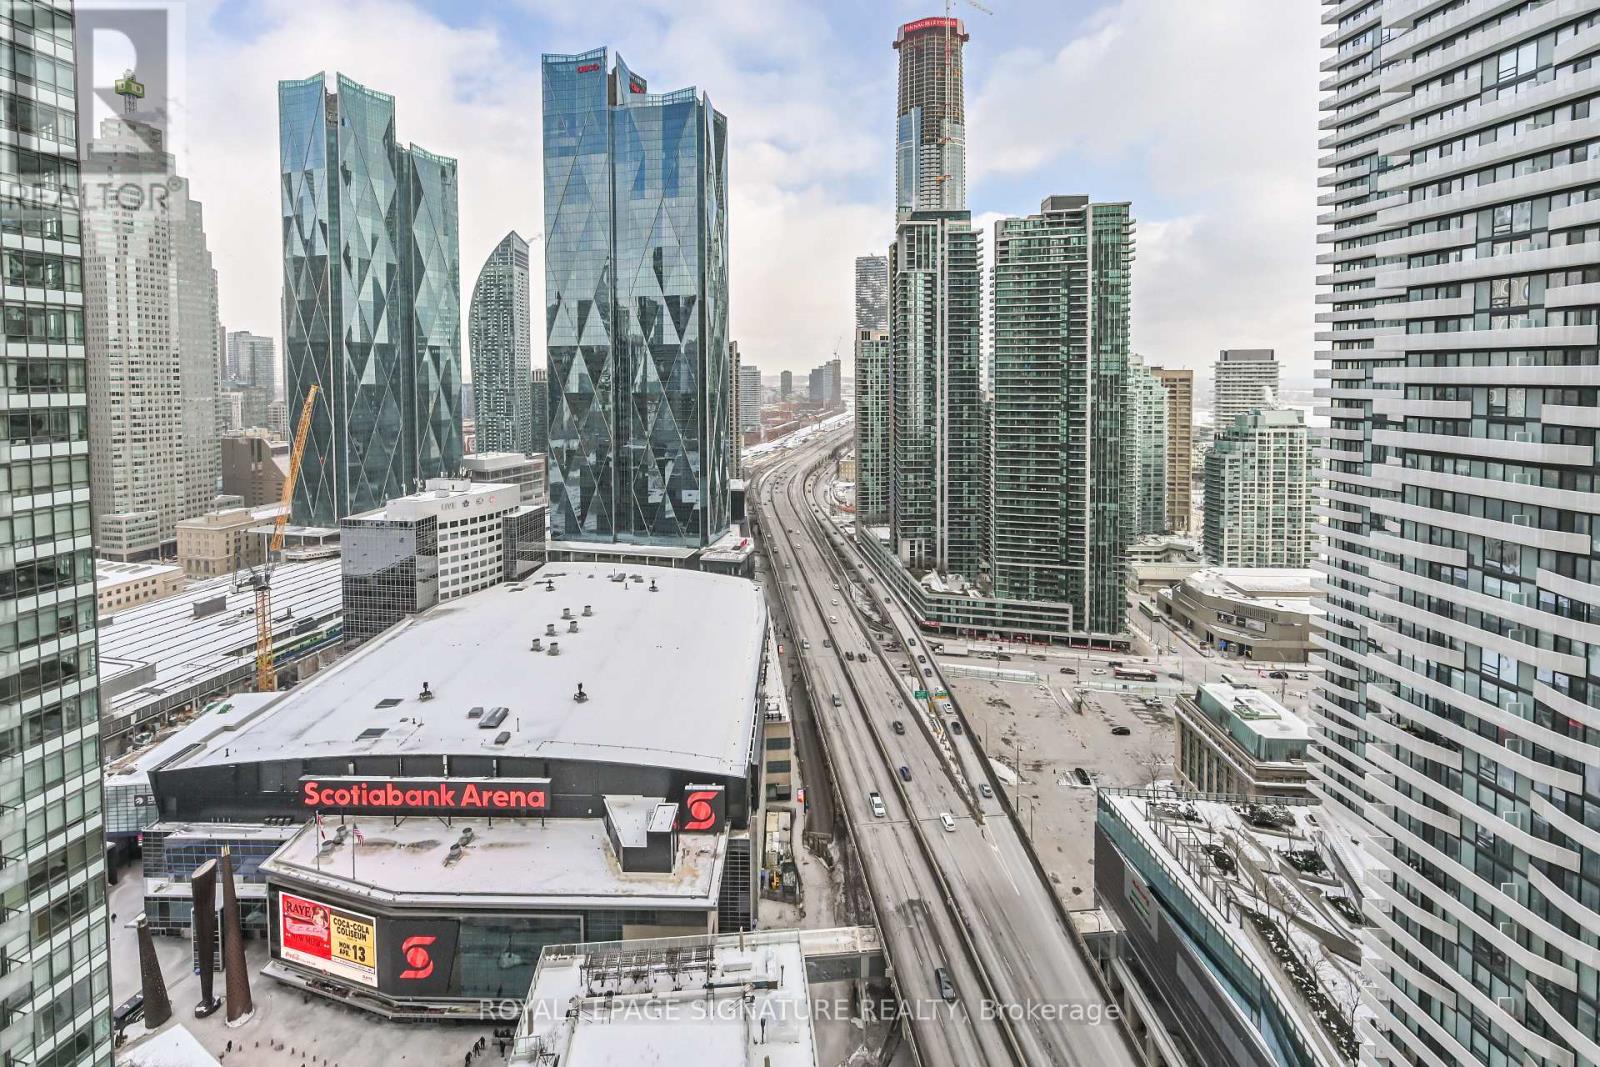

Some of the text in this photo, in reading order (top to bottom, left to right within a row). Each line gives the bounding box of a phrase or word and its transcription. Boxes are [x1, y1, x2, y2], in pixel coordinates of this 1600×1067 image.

[304, 782, 545, 807] Scotiabank Arena
[286, 900, 311, 918] RAYE
[333, 917, 370, 935] COCA-COLA
[336, 926, 367, 942] COLISEUM
[352, 944, 366, 963] 13
